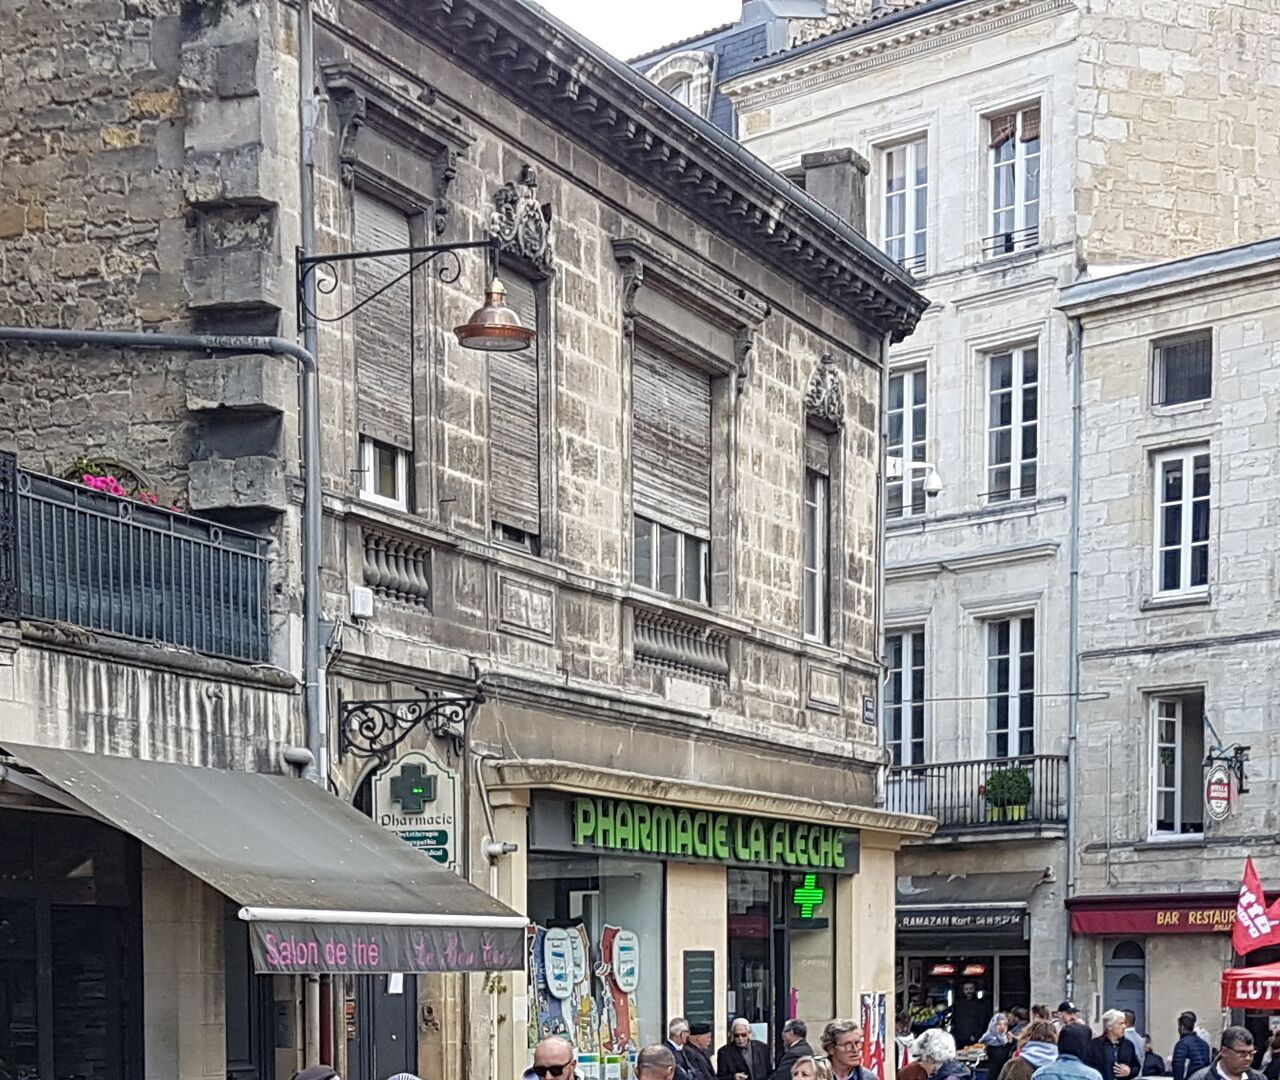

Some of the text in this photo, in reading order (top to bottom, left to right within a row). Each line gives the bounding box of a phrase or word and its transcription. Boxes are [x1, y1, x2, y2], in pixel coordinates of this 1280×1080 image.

[380, 813, 453, 827] Pharmacie
[576, 798, 845, 868] PHARMACIE LA FLECHE
[1156, 908, 1237, 925] BAR RESTAUR
[264, 933, 319, 966] Salon
[325, 937, 347, 966] de
[353, 936, 380, 966] thé
